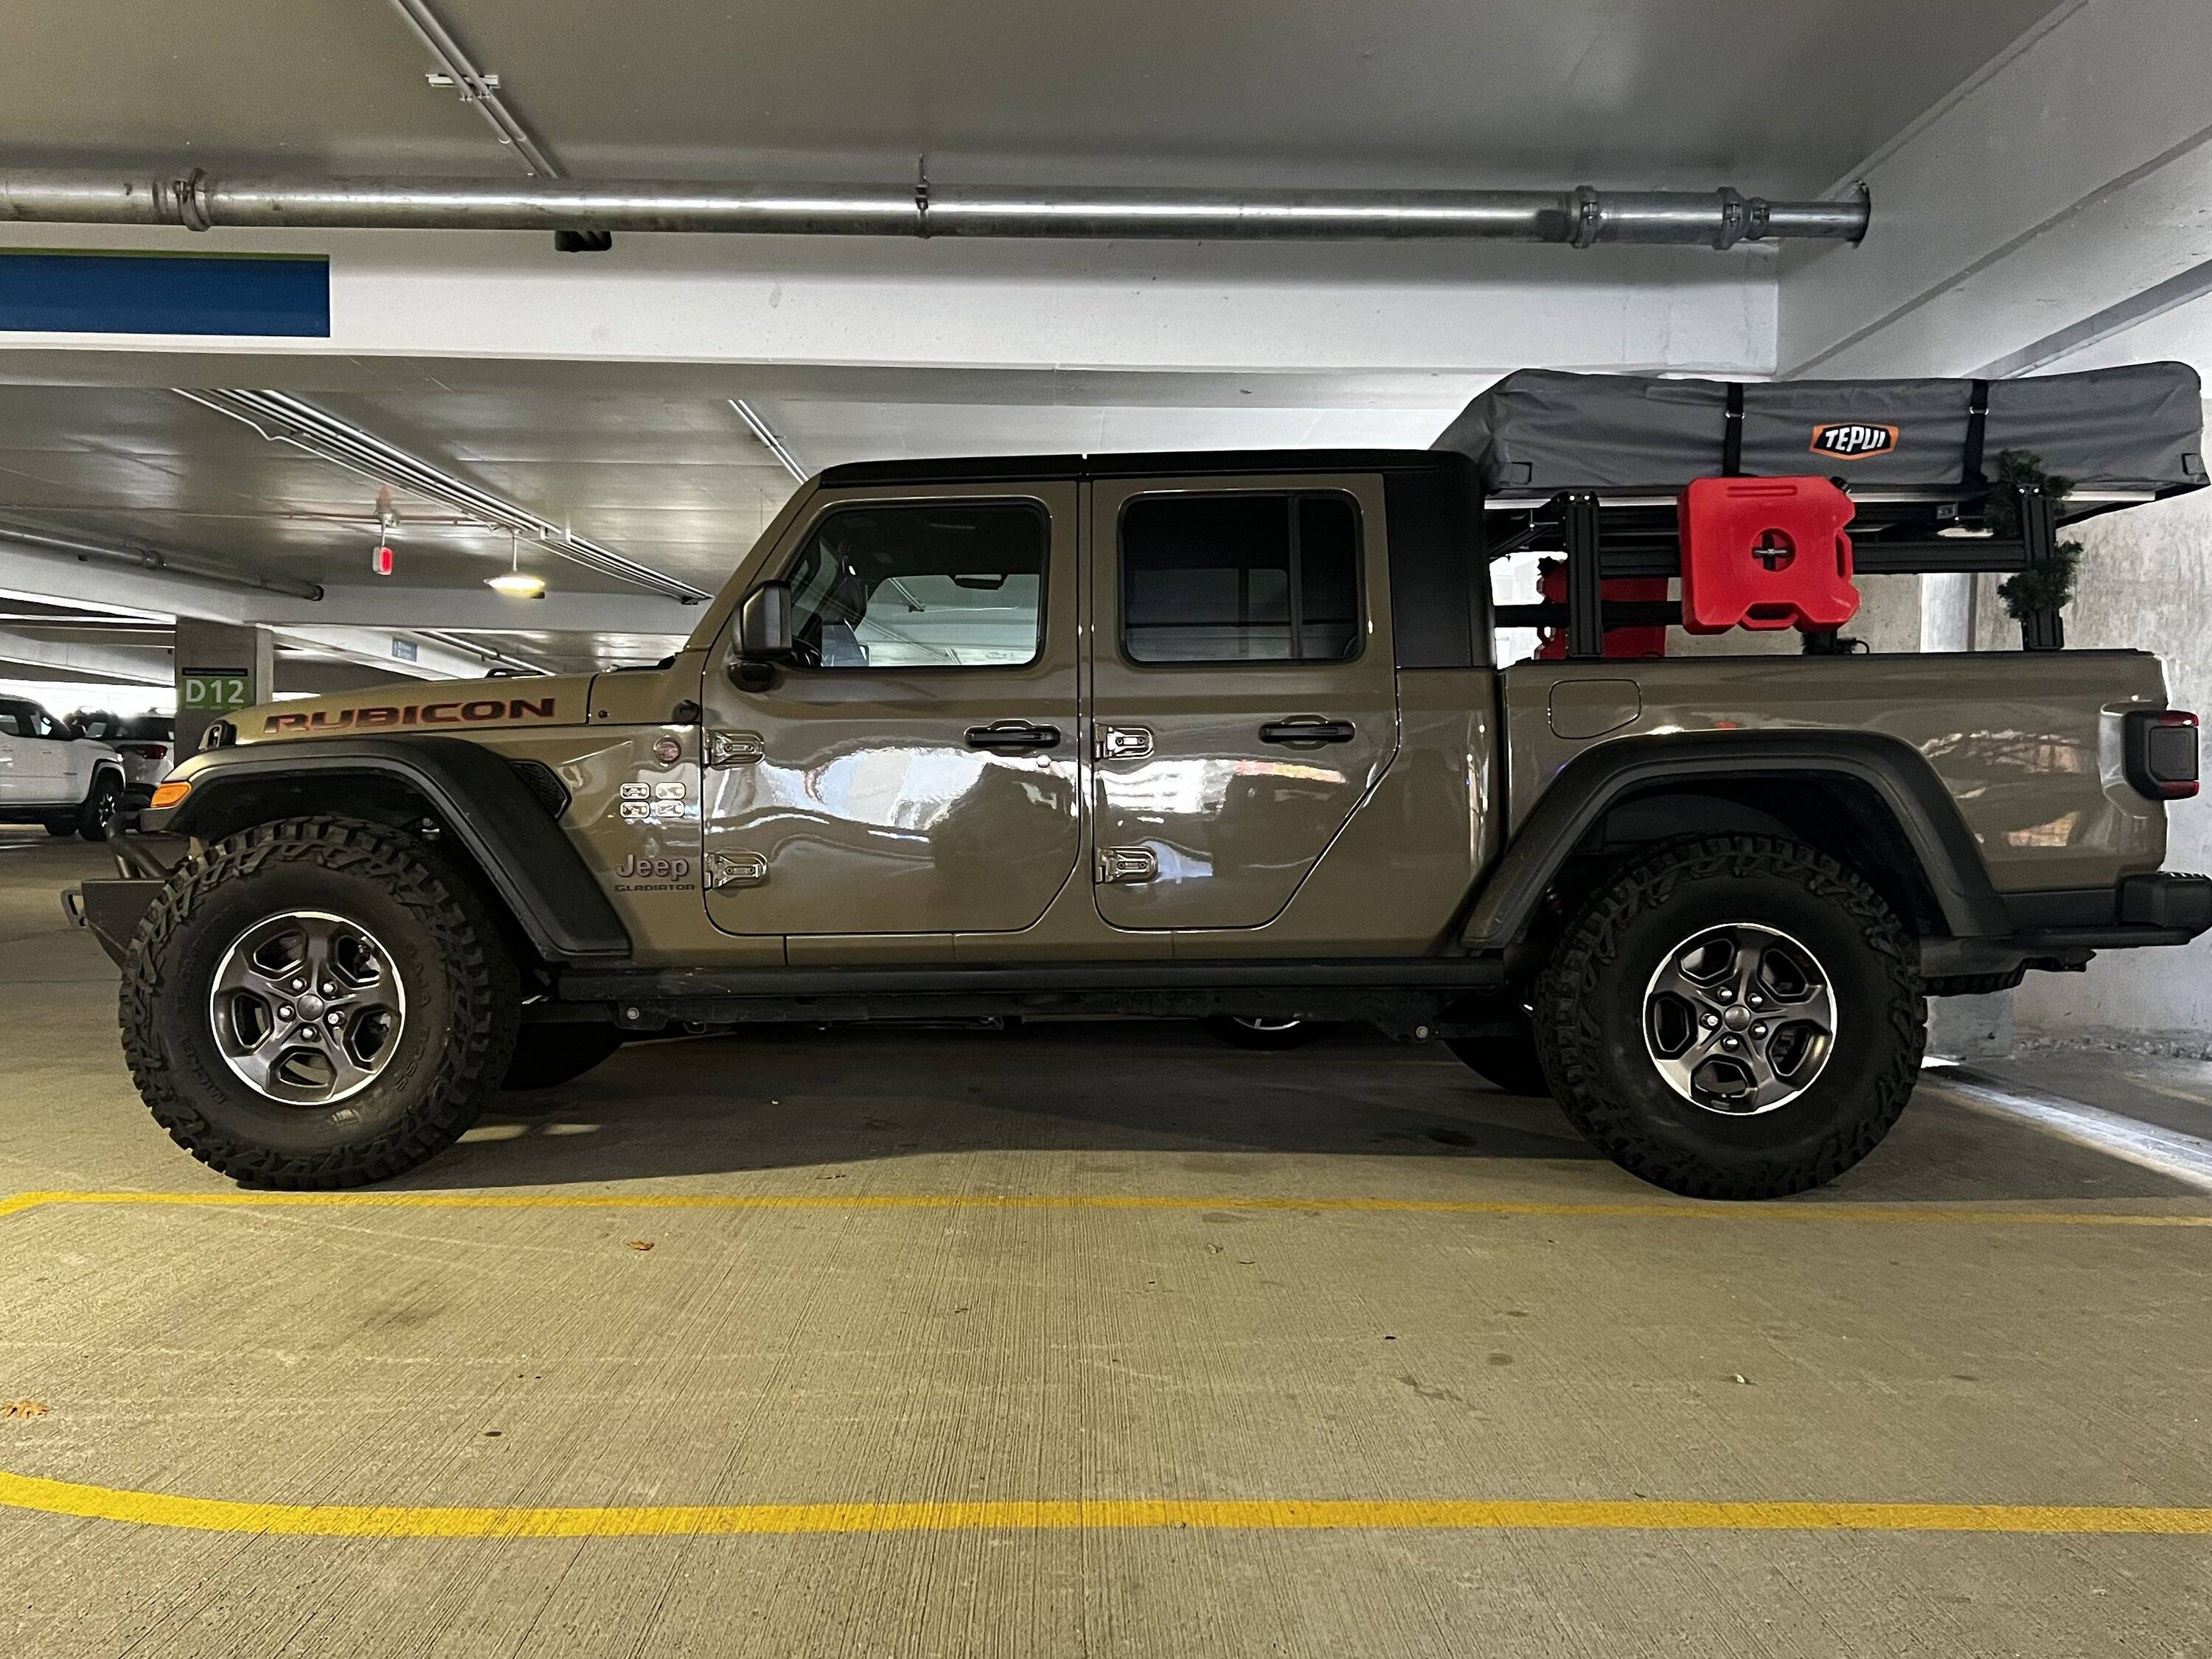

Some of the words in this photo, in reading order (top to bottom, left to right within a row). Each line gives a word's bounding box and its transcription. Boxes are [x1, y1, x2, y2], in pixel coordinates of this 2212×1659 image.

[1825, 425, 1886, 453] TEPUI
[186, 678, 244, 703] D12
[263, 698, 556, 734] RUBICON
[616, 854, 689, 882] Jeep
[613, 883, 696, 892] GLADIATOR
